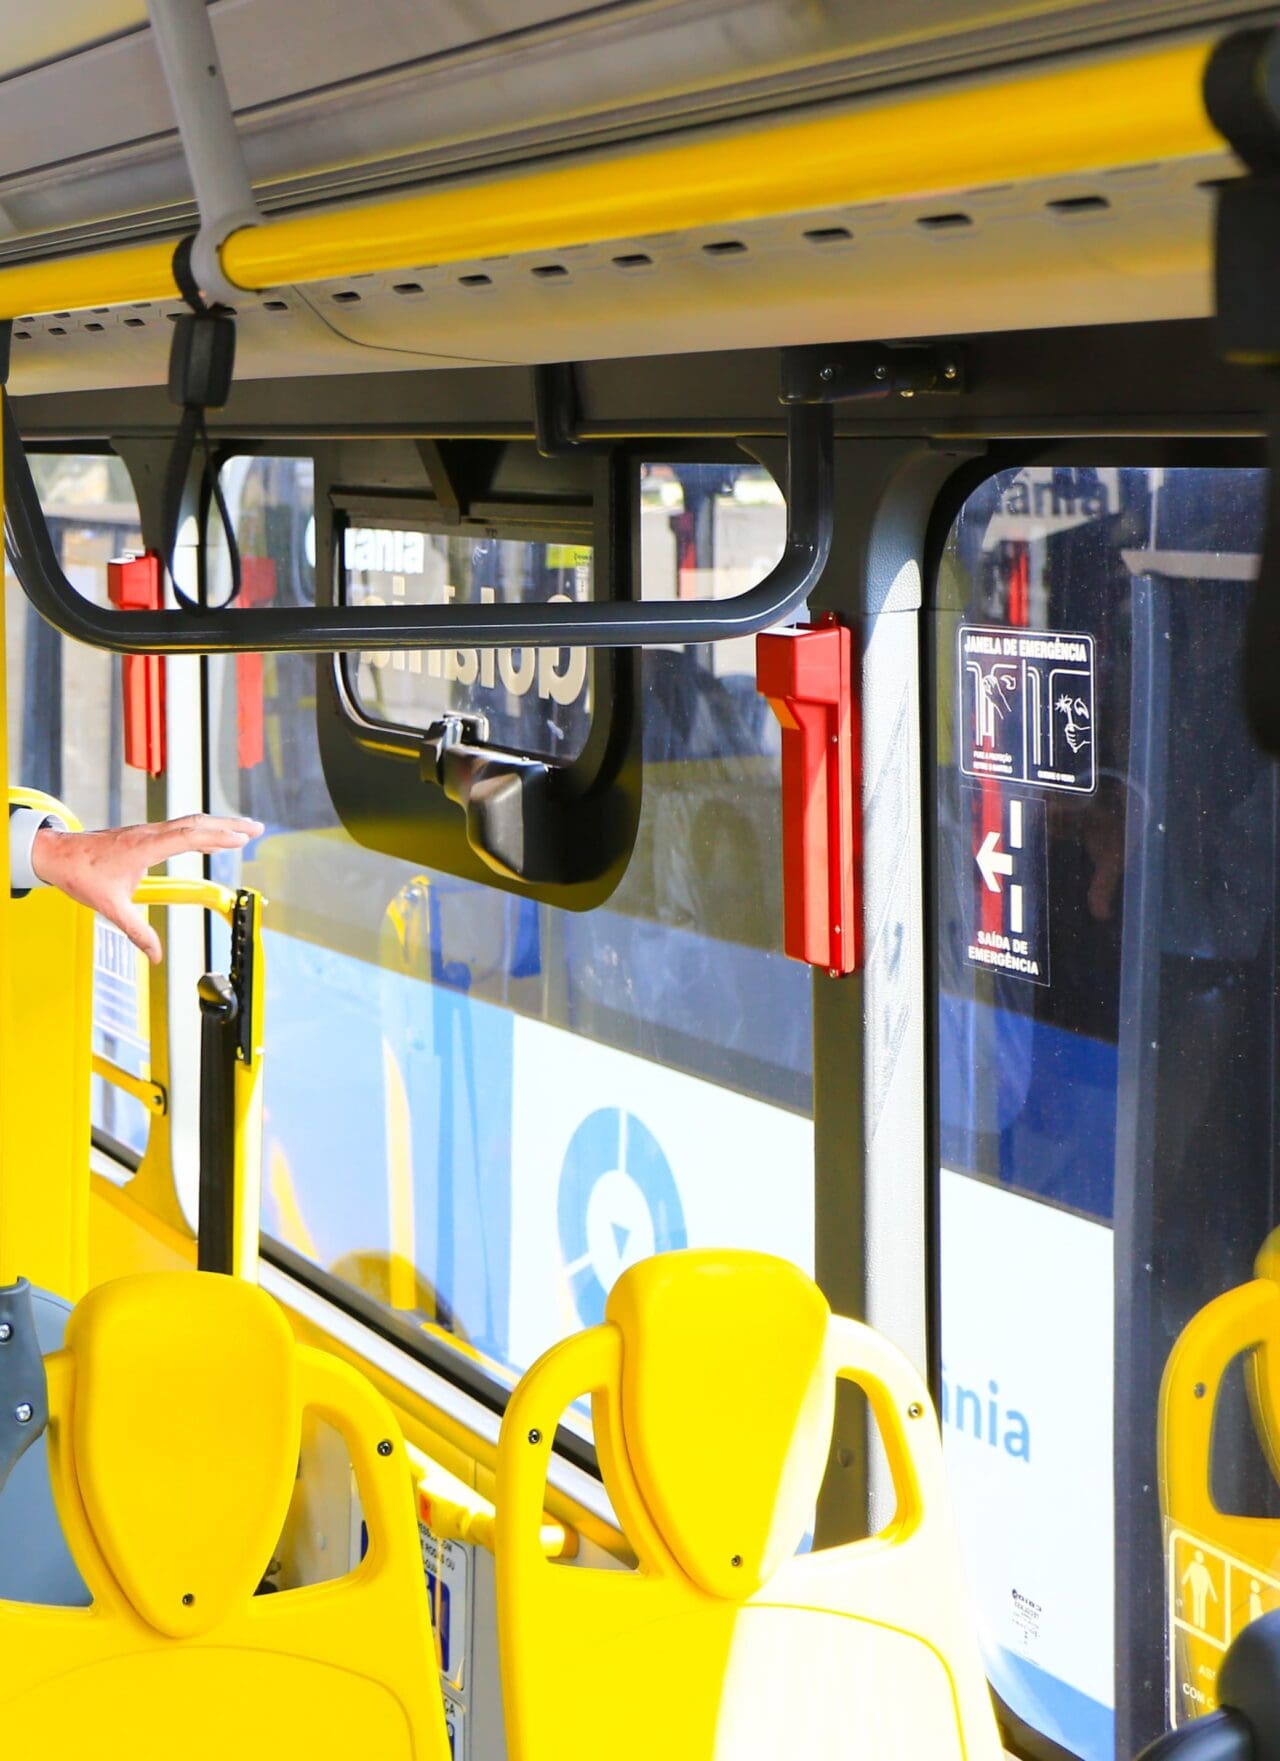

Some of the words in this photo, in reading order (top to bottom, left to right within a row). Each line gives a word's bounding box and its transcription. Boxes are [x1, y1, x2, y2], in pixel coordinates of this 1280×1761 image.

[964, 635, 1002, 655] JANELA
[1003, 638, 1018, 657] DE
[1019, 637, 1087, 662] EMERGÊNCIA
[977, 931, 1010, 951] SAÍDA
[1012, 938, 1028, 955] DE
[968, 945, 1039, 975] EMERGÊNCIA
